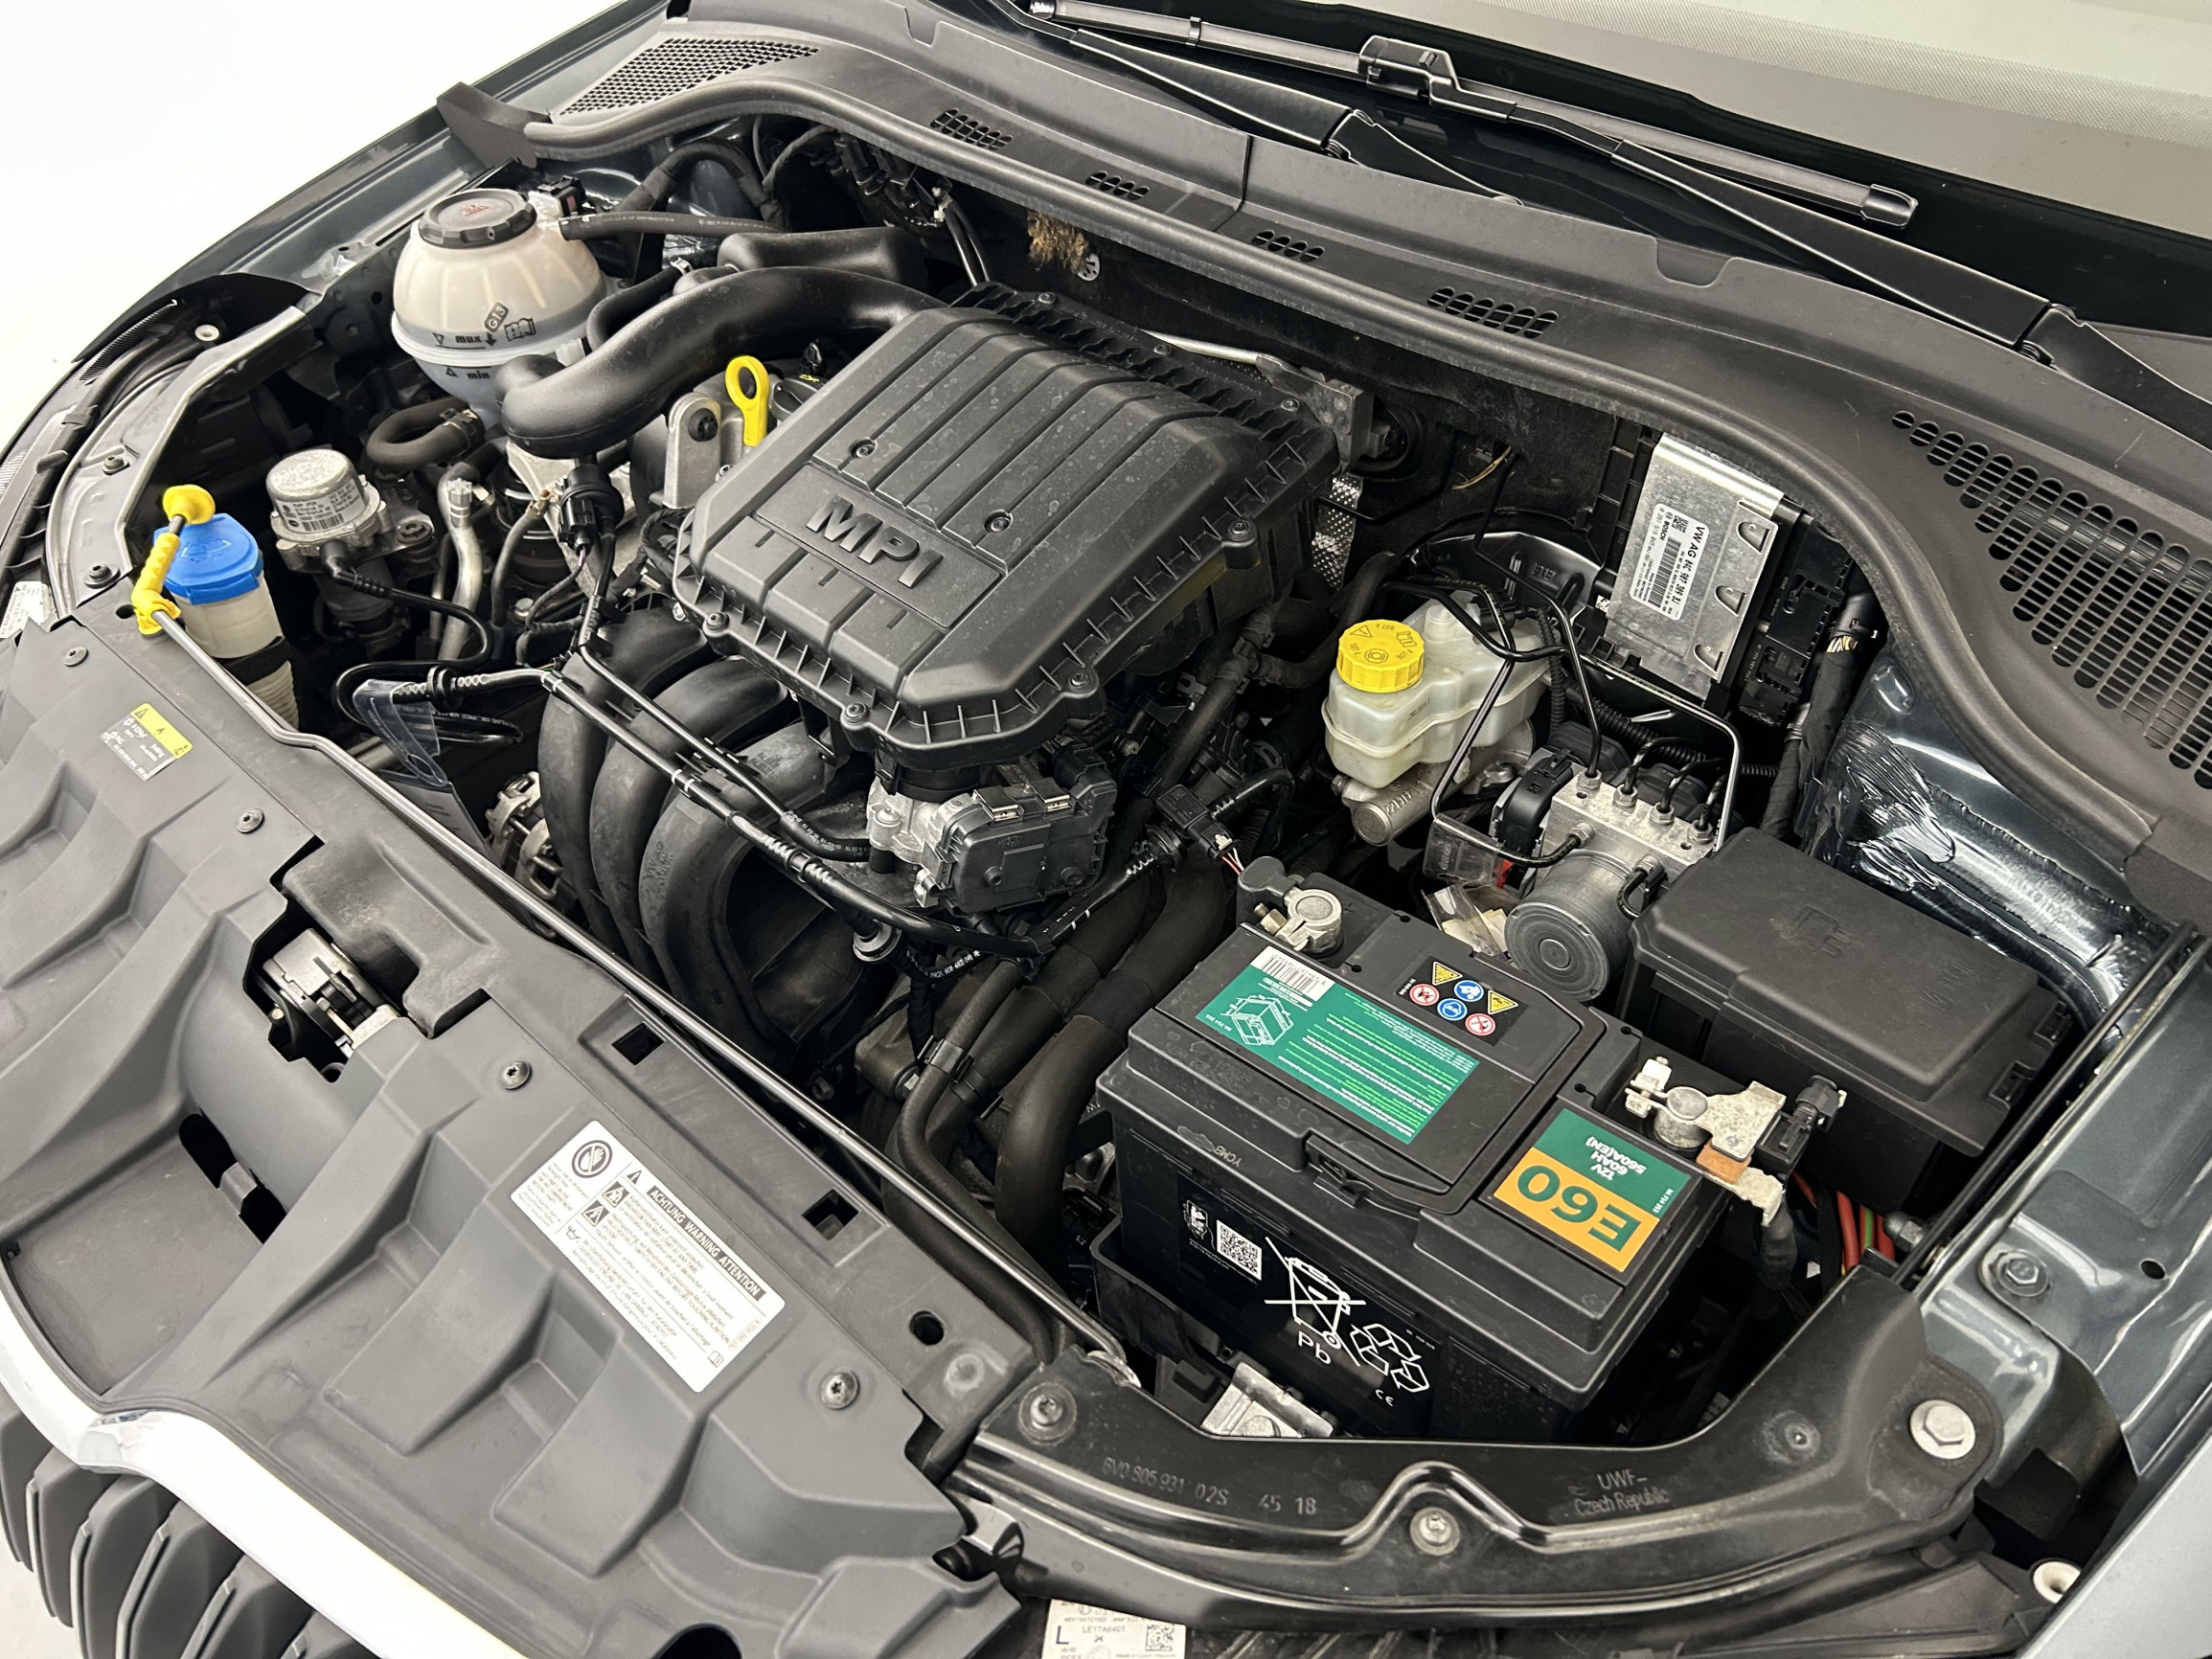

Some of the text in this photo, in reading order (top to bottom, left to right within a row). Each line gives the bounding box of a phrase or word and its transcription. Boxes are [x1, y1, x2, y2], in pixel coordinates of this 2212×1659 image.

[488, 307, 506, 330] G13
[455, 335, 482, 344] max
[467, 370, 490, 379] min
[1659, 521, 1669, 539] BOSCH
[1693, 526, 1704, 542] VW
[806, 495, 944, 589] MPI
[1688, 543, 1699, 557] AG
[1215, 1144, 1242, 1167] YCMB
[1585, 1136, 1648, 1174] 560A(EN)
[1590, 1150, 1629, 1175] 60AH
[1589, 1162, 1616, 1180] 12V
[1517, 1165, 1643, 1252] E60
[650, 1192, 760, 1296] ACHTUNG WARNING ATTENTION
[1298, 1330, 1332, 1365] Pb
[1102, 1456, 1130, 1479] 6V0
[1159, 1472, 1185, 1495] 931
[1195, 1483, 1230, 1507] 02S
[1259, 1493, 1282, 1512] 45
[1294, 1496, 1318, 1515] 18
[1574, 1486, 1670, 1516] Czech Republic
[1056, 1625, 1069, 1645] L
